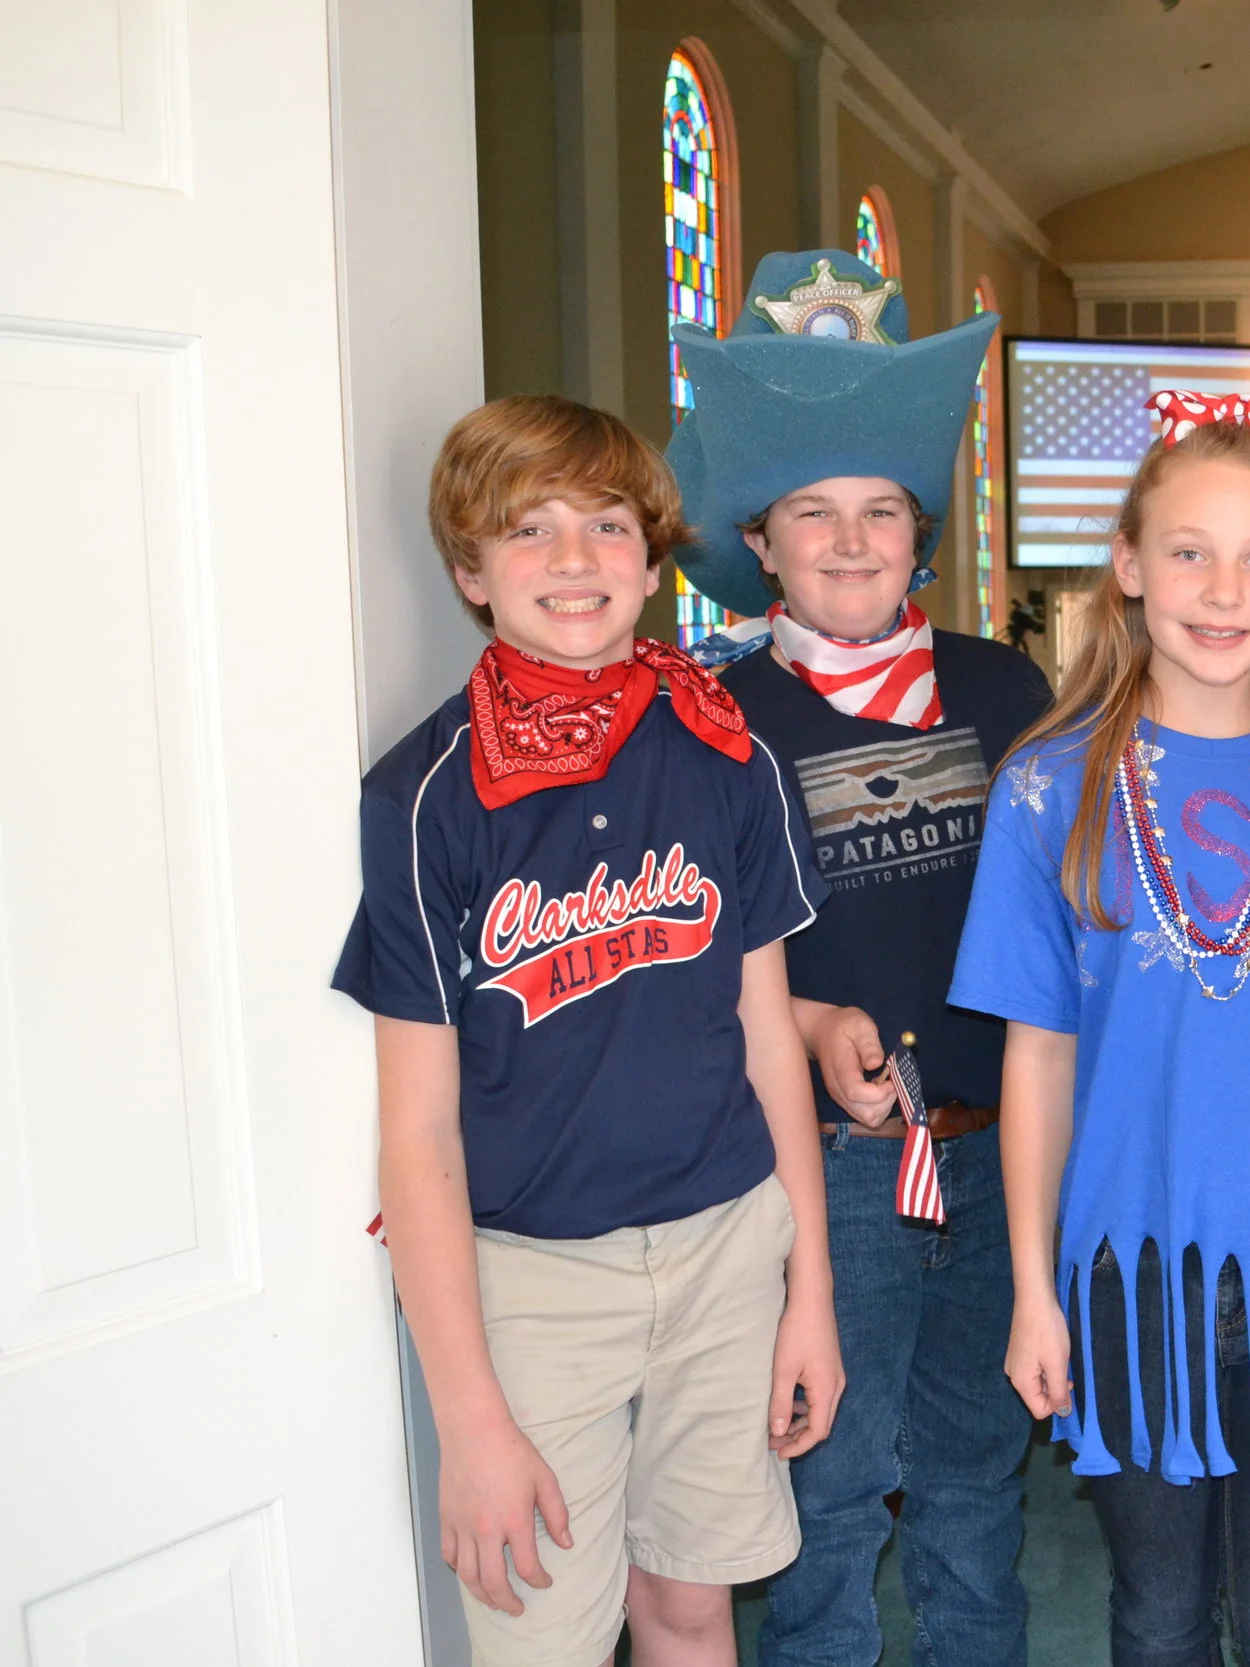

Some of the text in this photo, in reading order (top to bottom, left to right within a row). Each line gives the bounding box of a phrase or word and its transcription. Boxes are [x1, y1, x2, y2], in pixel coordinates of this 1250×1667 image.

[793, 288, 859, 302] PEACE OFFICER
[816, 814, 975, 870] PATAGONI
[873, 871, 892, 884] TO
[900, 856, 957, 879] ENDURE
[605, 927, 669, 969] STAS
